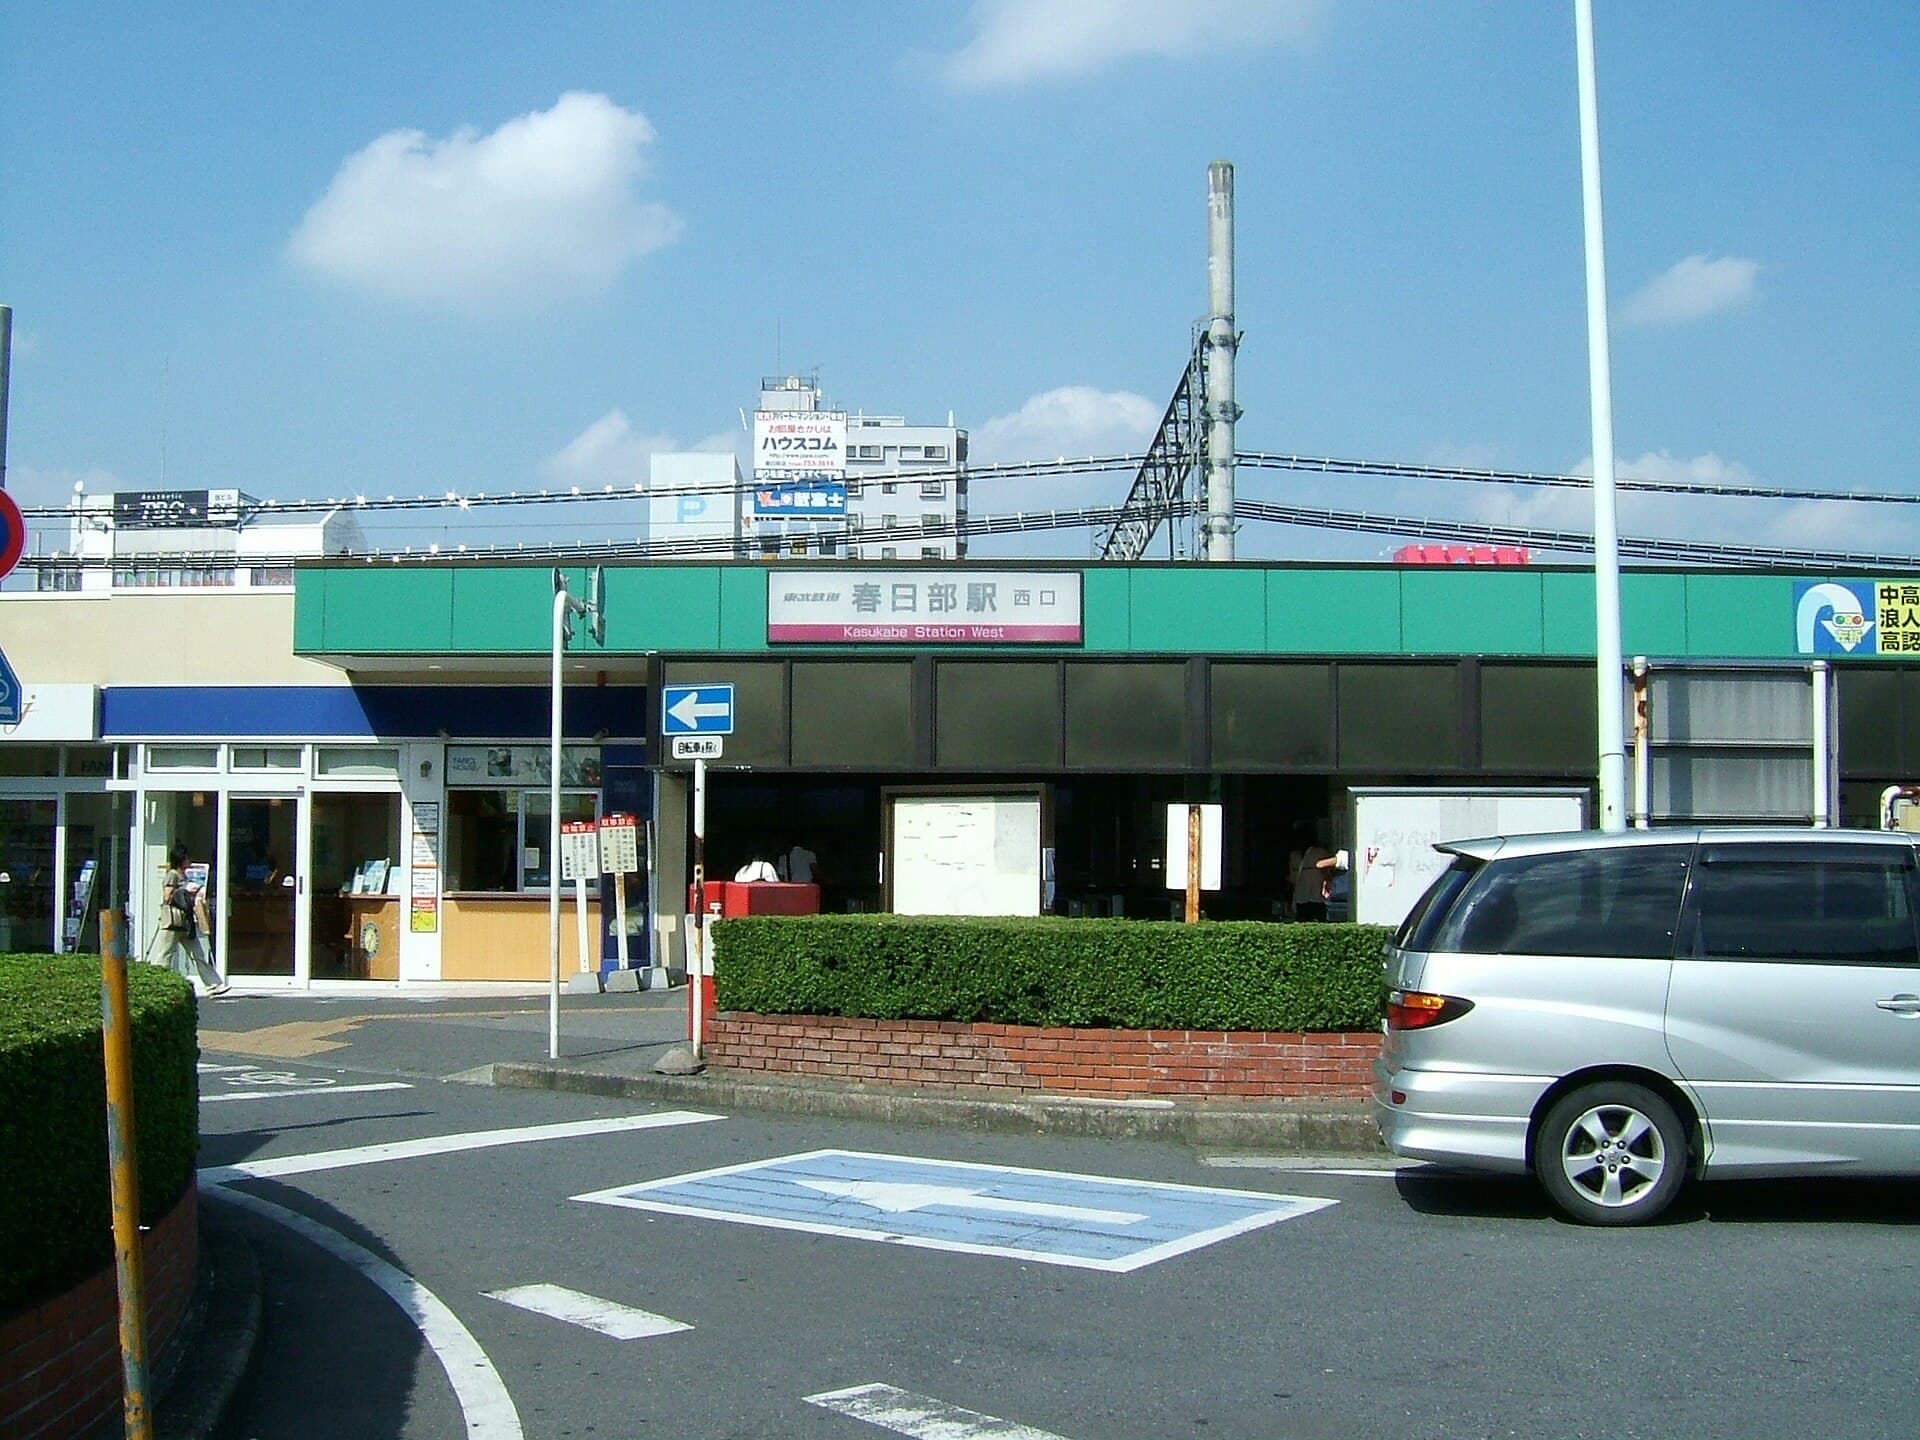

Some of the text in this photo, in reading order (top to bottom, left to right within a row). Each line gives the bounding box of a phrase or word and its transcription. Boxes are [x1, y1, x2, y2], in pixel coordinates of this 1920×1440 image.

[762, 436, 837, 450] ハウスコム
[676, 496, 707, 523] P
[851, 581, 998, 613] 春日部駅
[1013, 588, 1056, 607] 西口
[1879, 585, 1920, 606] 中高
[1879, 608, 1920, 629] 浪人
[843, 625, 1004, 639] Kasukabe Station West
[1880, 630, 1920, 652] 高認
